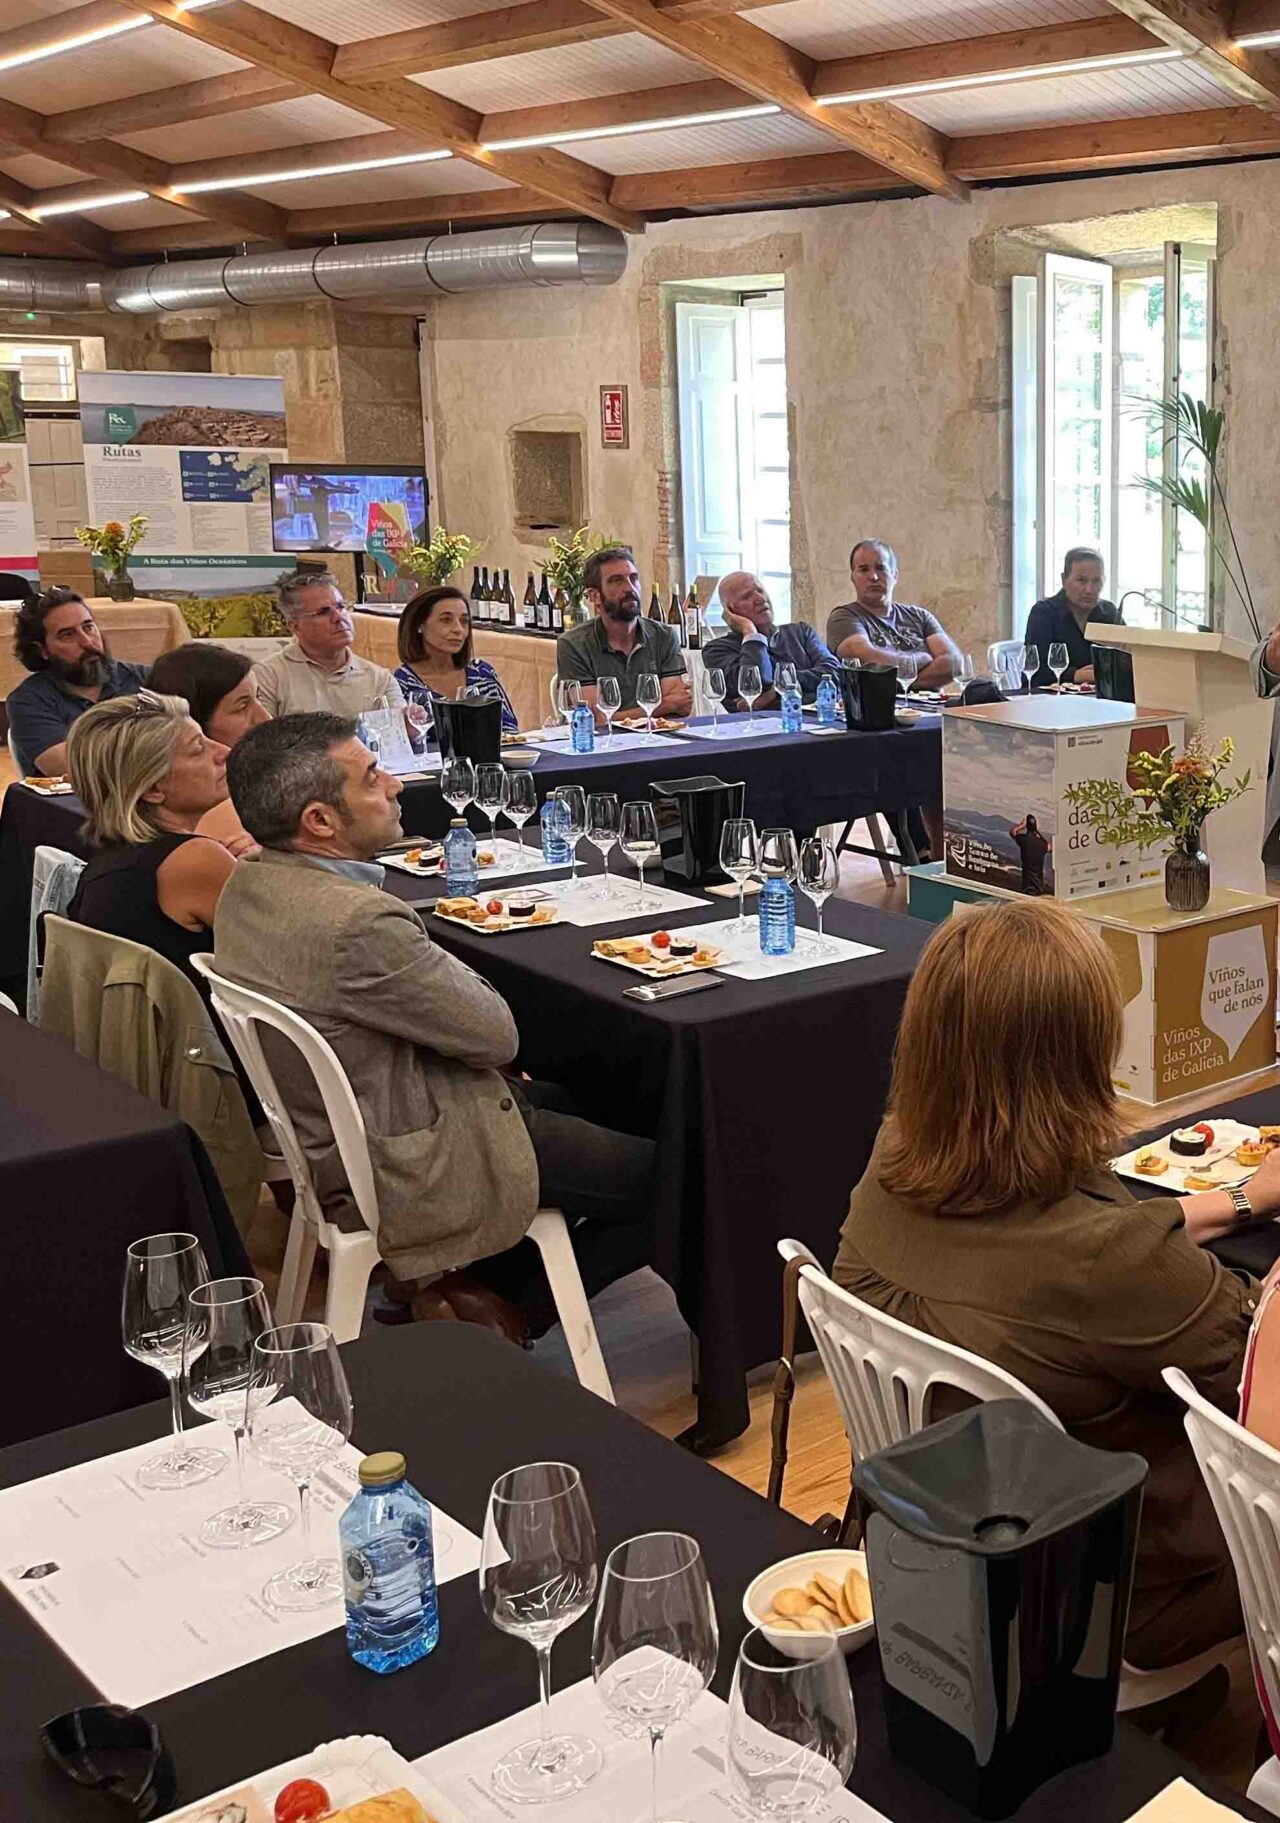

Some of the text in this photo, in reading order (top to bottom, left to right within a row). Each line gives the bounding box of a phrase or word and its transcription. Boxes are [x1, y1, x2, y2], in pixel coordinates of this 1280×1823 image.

[103, 446, 141, 457] Rutas
[1068, 830, 1090, 849] de
[1209, 966, 1245, 985] Viños
[1208, 977, 1264, 1004] que falan
[1223, 992, 1263, 1014] de nós
[1163, 1026, 1200, 1046] Viños
[1162, 1037, 1212, 1065] das IXP
[1162, 1053, 1224, 1083] de Galicia
